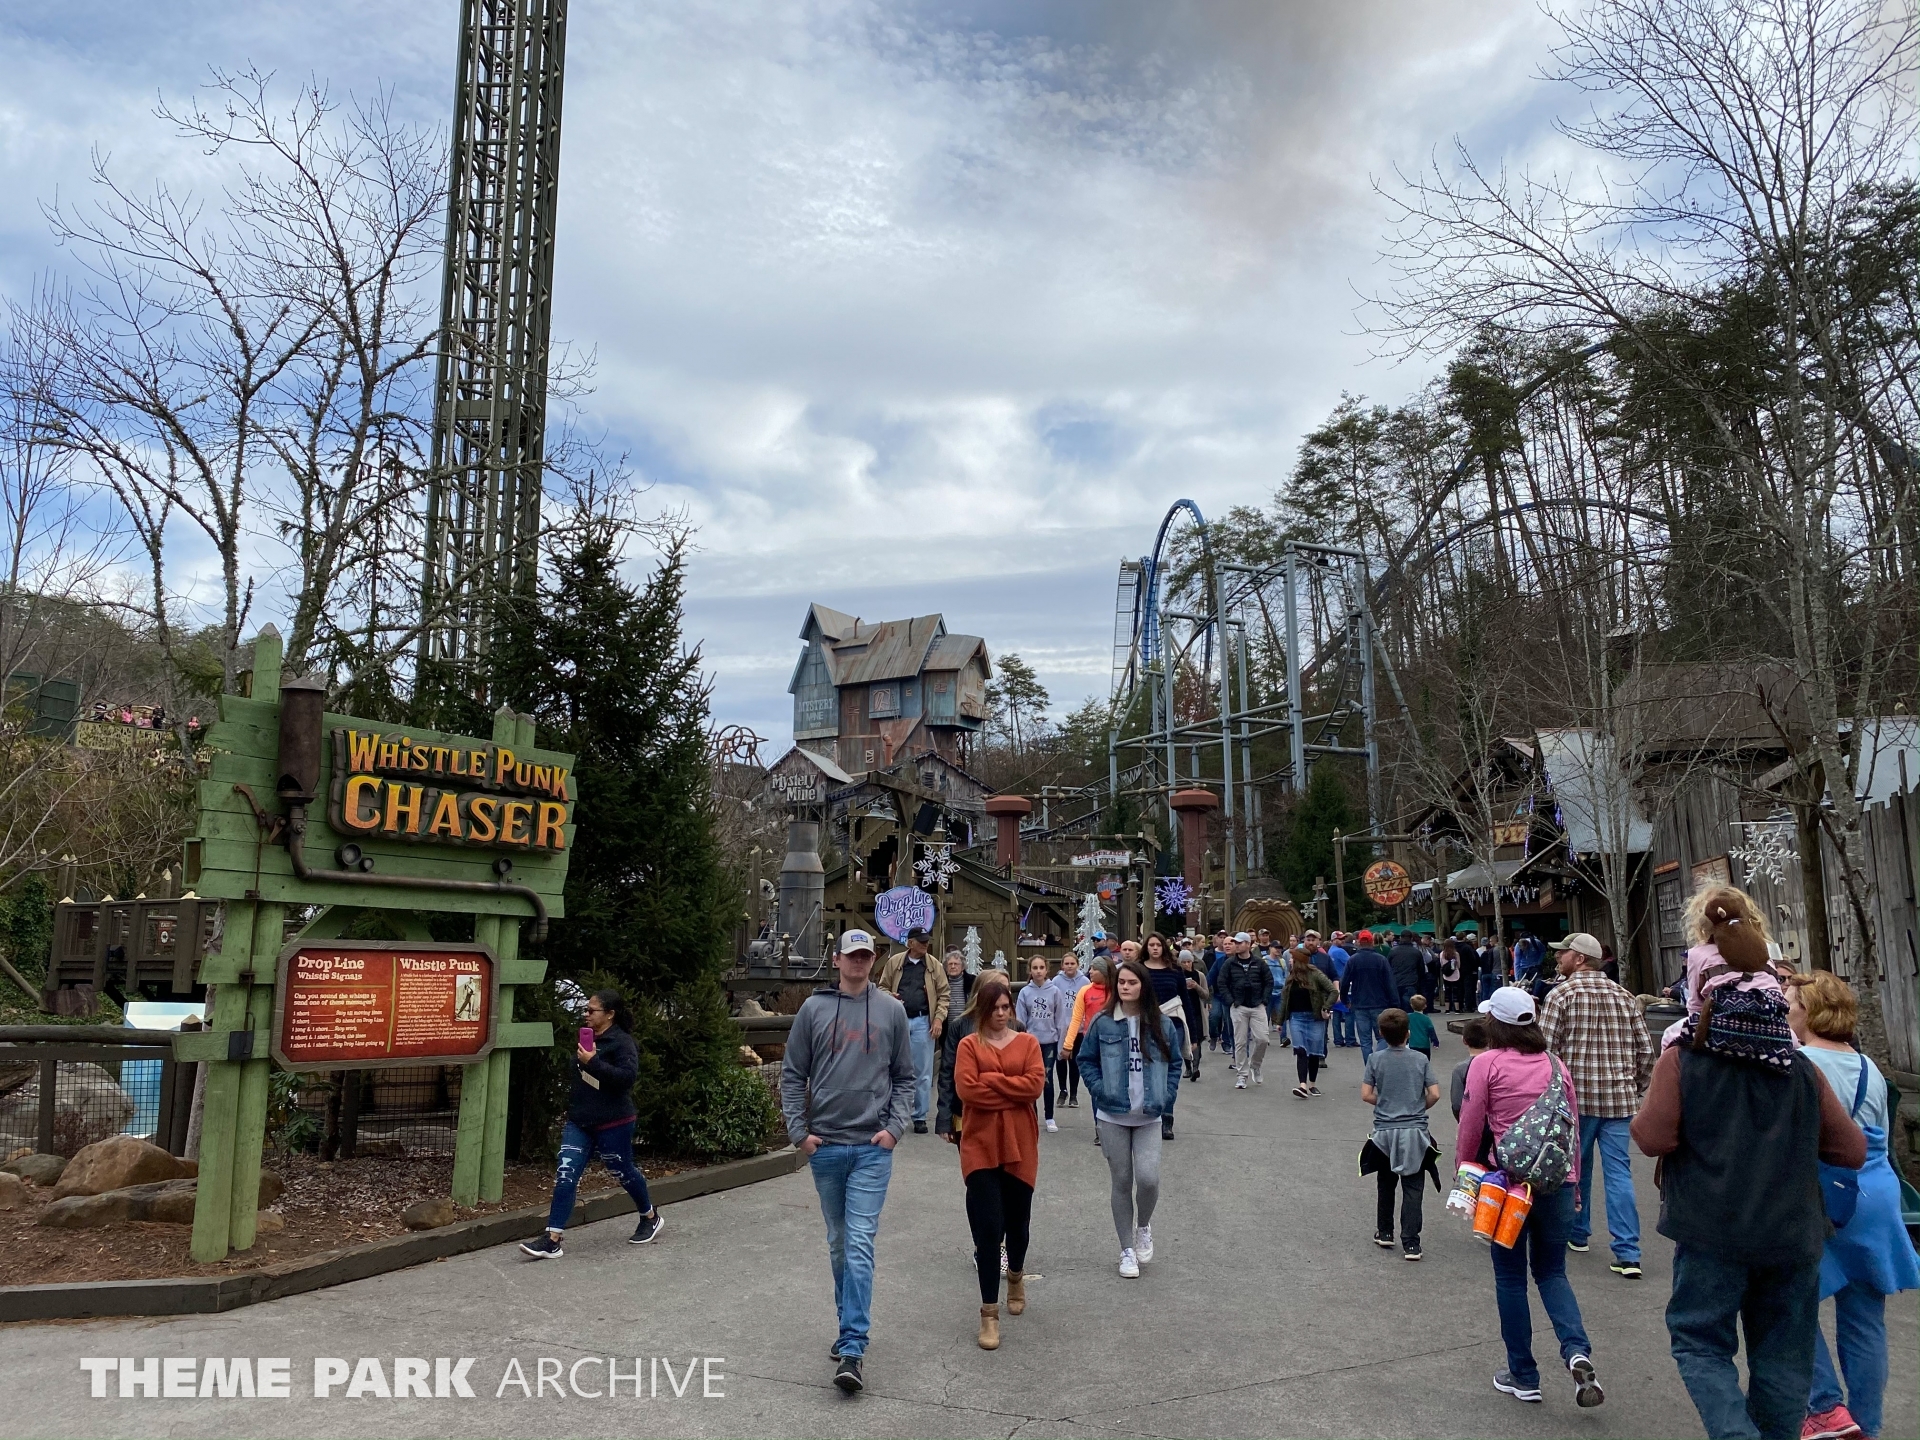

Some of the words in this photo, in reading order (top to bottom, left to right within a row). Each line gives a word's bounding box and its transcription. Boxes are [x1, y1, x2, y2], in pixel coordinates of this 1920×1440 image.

[798, 699, 833, 712] MYSTERY
[806, 712, 824, 721] MINE
[495, 749, 568, 802] PUNK
[772, 774, 817, 791] Mystery
[786, 787, 816, 802] Mine
[344, 776, 567, 850] CHASER
[1365, 878, 1412, 894] PIZZA
[875, 893, 911, 917] Drop
[910, 886, 933, 907] Line
[298, 956, 332, 972] Drop
[334, 956, 364, 970] Line
[400, 957, 446, 972] Whistle
[448, 958, 479, 972] Punk
[297, 972, 330, 981] Whistle
[332, 971, 362, 981] Signals
